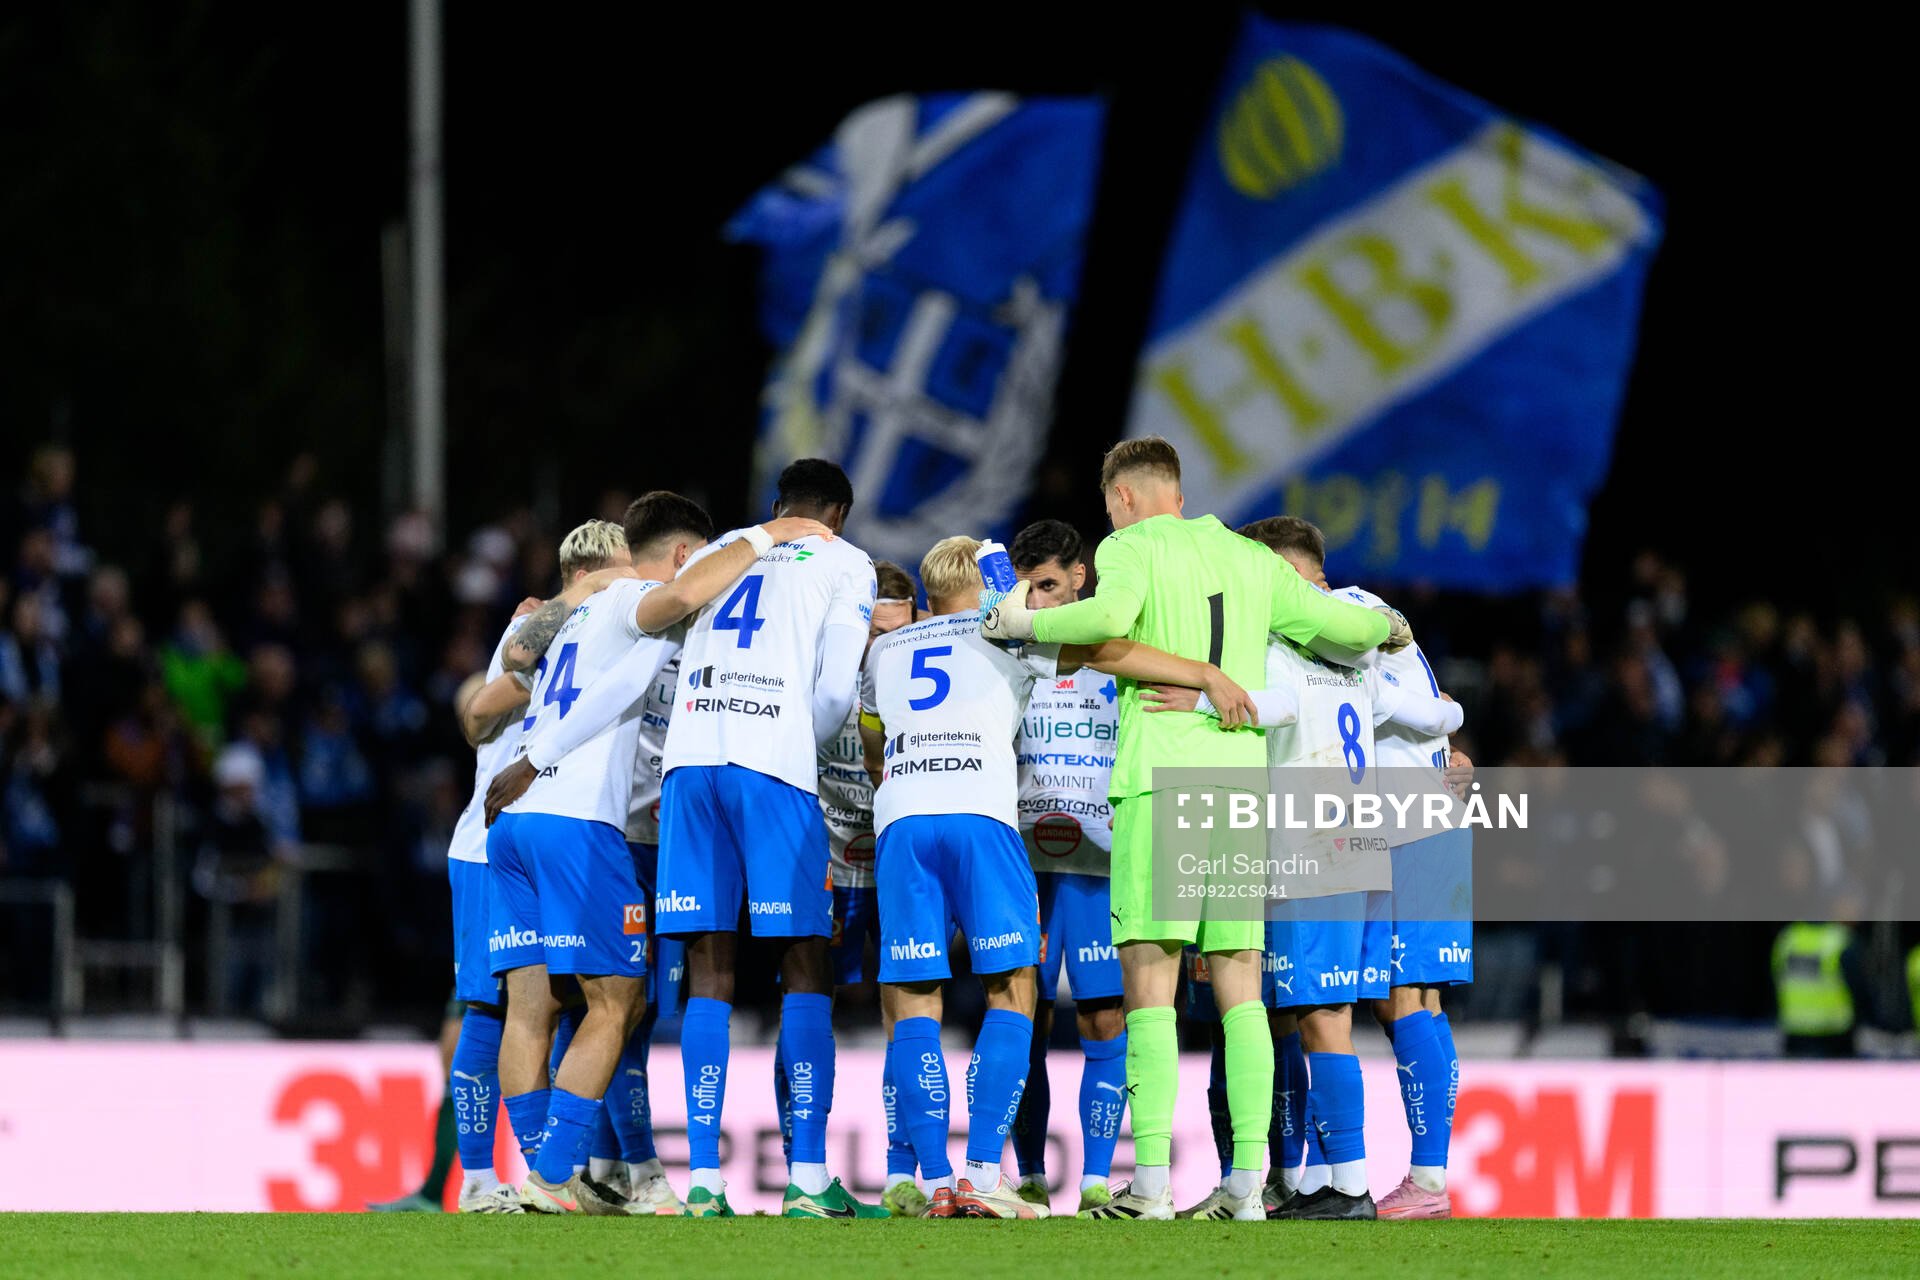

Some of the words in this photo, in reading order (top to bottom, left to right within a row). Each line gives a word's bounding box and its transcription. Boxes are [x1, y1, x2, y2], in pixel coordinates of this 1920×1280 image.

[772, 541, 805, 551] nergi
[712, 575, 766, 649] 4
[948, 616, 981, 625] Energ
[1207, 592, 1224, 669] 1
[908, 645, 953, 711] 5
[910, 731, 982, 749] gjuteriteknik
[1022, 716, 1119, 744] liljedah
[1337, 702, 1366, 786] 8
[891, 757, 979, 779] RIMEDA
[1032, 773, 1096, 790] NOMINIT
[826, 804, 874, 823] everb
[1018, 797, 1110, 816] everbrand
[1349, 836, 1388, 852] RIMED
[751, 901, 793, 915] RAVEMA
[543, 935, 587, 948] AVEMA
[979, 931, 1024, 951] RAVEMA
[692, 1064, 721, 1110] office
[791, 1061, 813, 1104] office
[918, 1052, 947, 1102] office
[473, 1085, 490, 1134] OFFICE
[693, 1113, 715, 1125] 4
[793, 1108, 812, 1120] 4
[925, 1108, 948, 1120] 4
[1407, 1082, 1428, 1136] OFFICE
[1103, 1102, 1121, 1139] OFFICE
